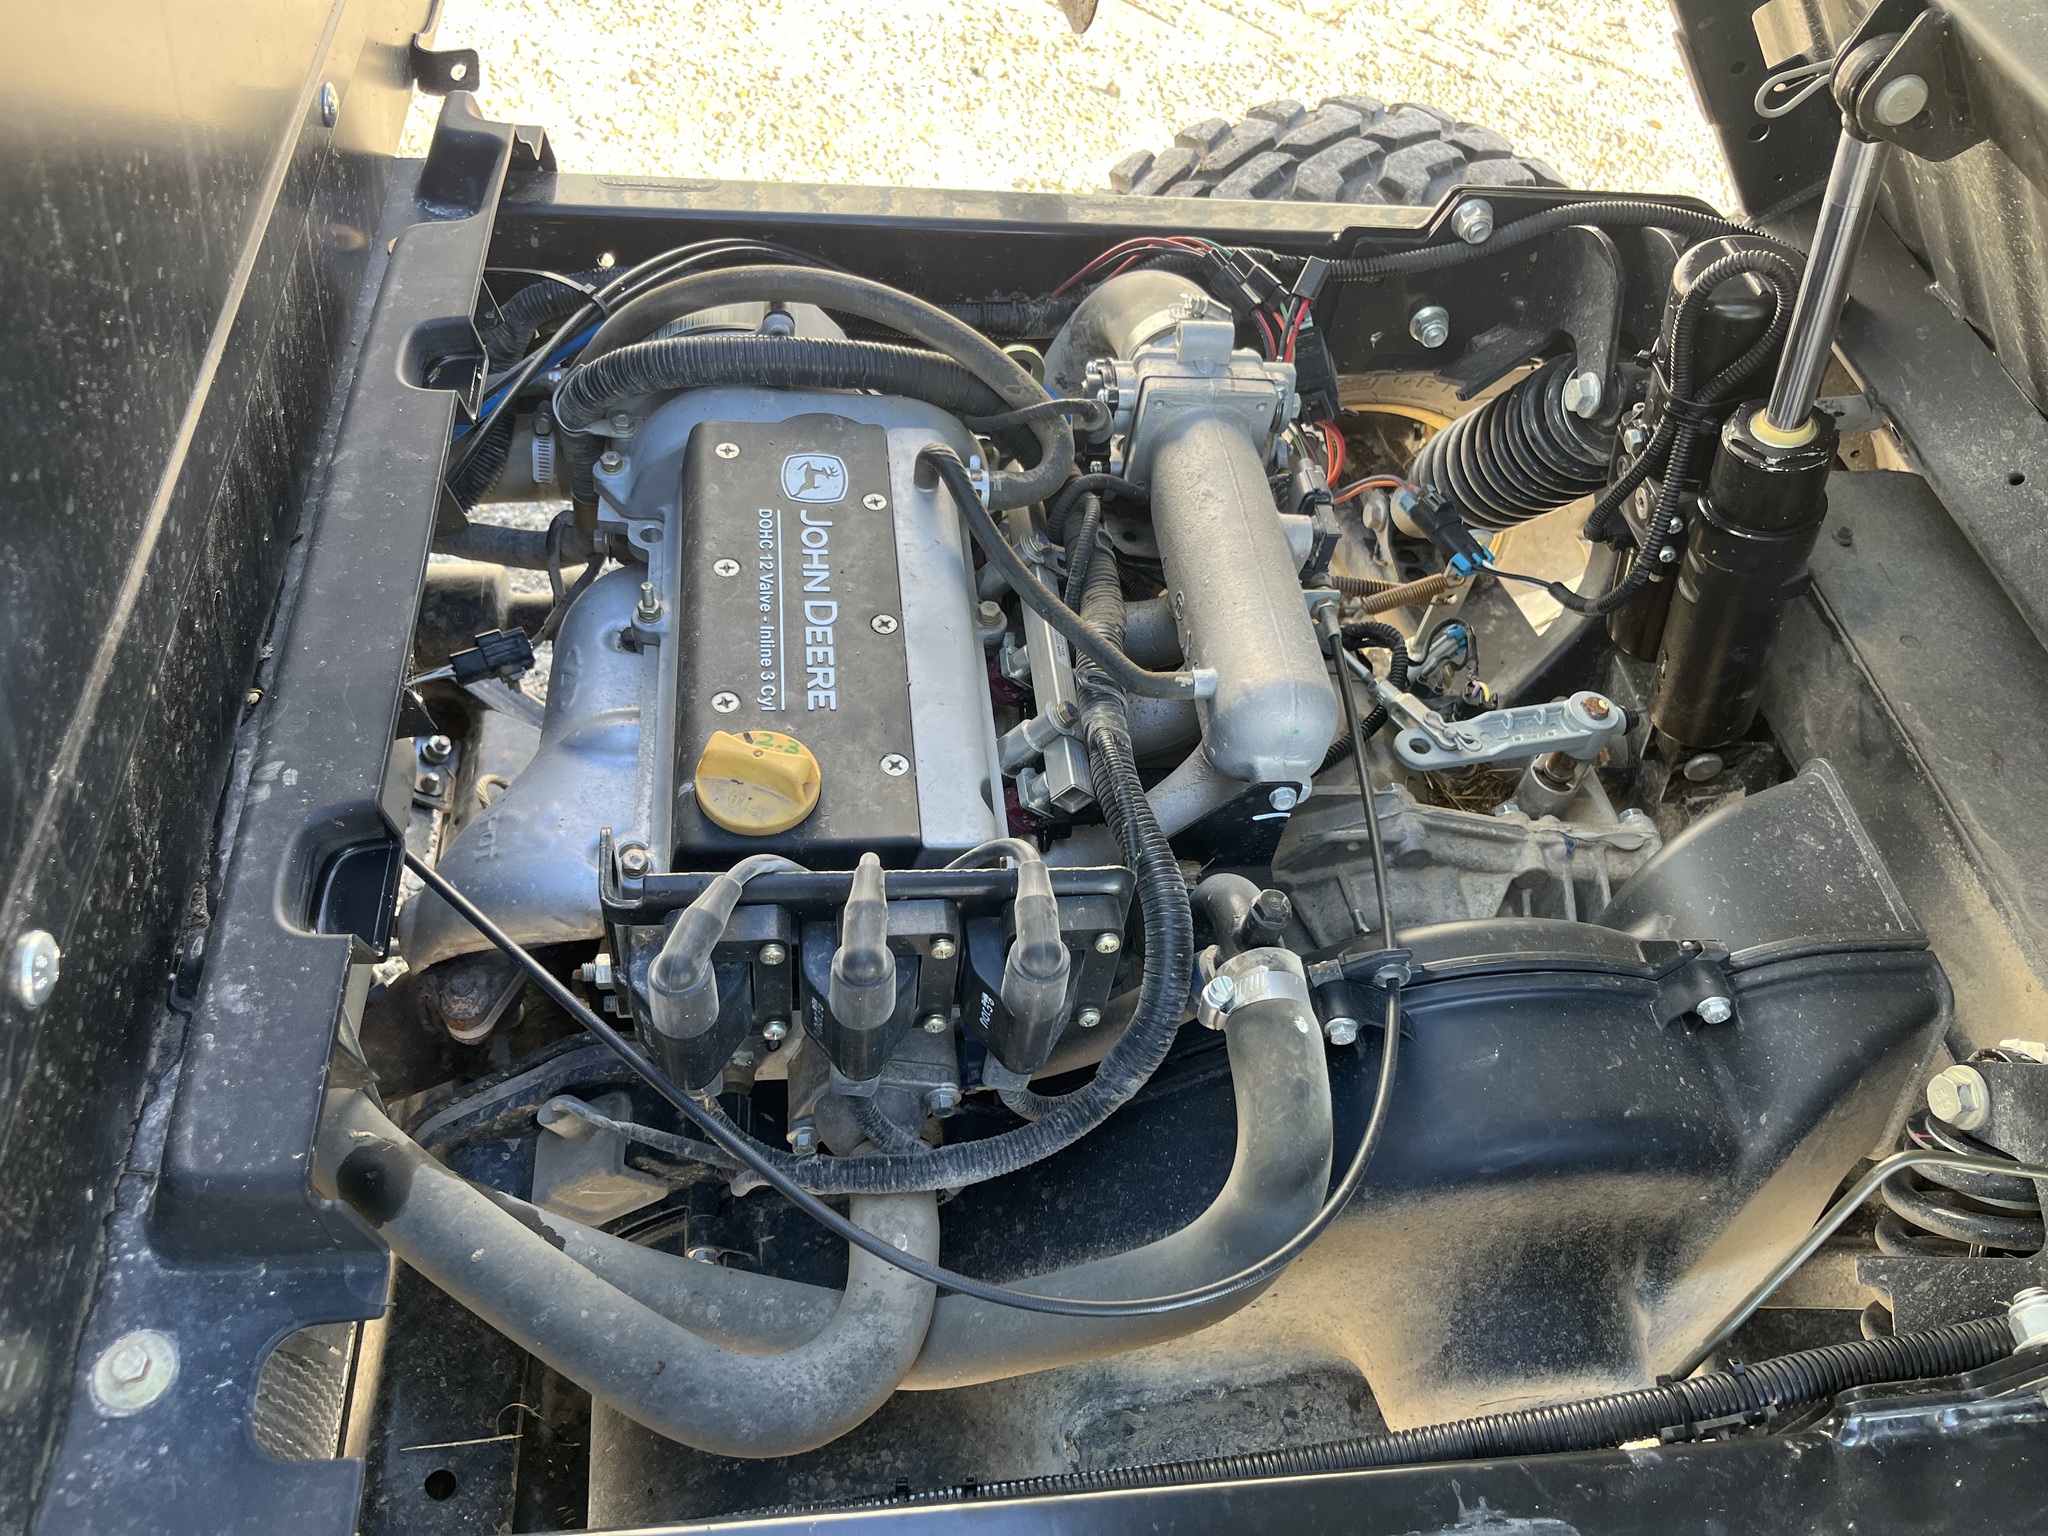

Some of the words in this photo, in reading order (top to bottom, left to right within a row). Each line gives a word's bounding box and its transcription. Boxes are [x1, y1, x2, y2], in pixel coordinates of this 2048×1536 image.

[758, 508, 774, 550] DOHC
[759, 554, 774, 570] 12
[799, 509, 834, 593] JOHN
[759, 573, 775, 613] Valve
[760, 626, 775, 668] Inline
[804, 600, 838, 711] DEERE
[760, 672, 776, 682] 3
[757, 685, 777, 712] Cyl
[727, 793, 757, 813] OIL
